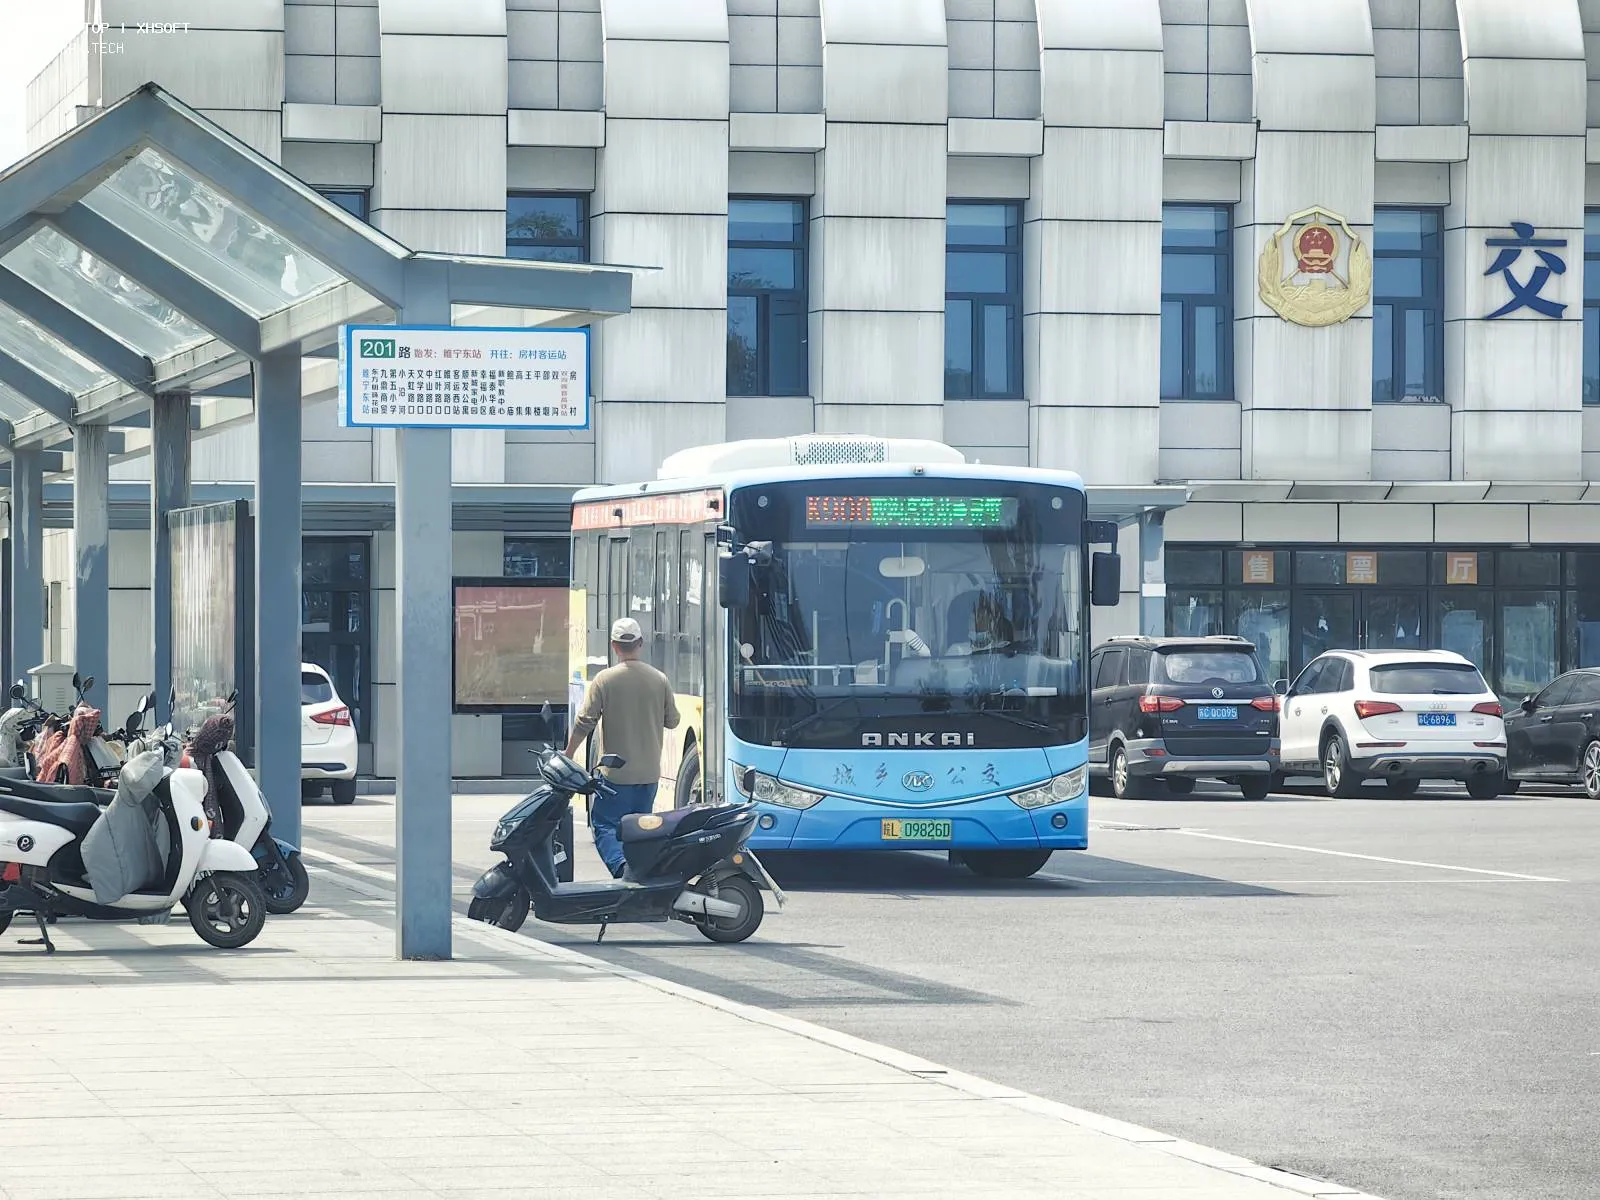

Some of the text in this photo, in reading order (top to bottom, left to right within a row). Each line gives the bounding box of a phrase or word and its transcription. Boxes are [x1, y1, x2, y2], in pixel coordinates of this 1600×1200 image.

[1484, 221, 1568, 320] 交
[389, 368, 397, 415] 第五小学
[407, 369, 415, 415] 天虹路口
[416, 369, 424, 415] 文学路口
[425, 369, 433, 415] 中山路口
[434, 369, 442, 415] 红叶路口
[452, 369, 460, 415] 客运西站
[479, 369, 487, 415] 幸福小区
[515, 370, 523, 416] 高集
[524, 370, 532, 416] 王集
